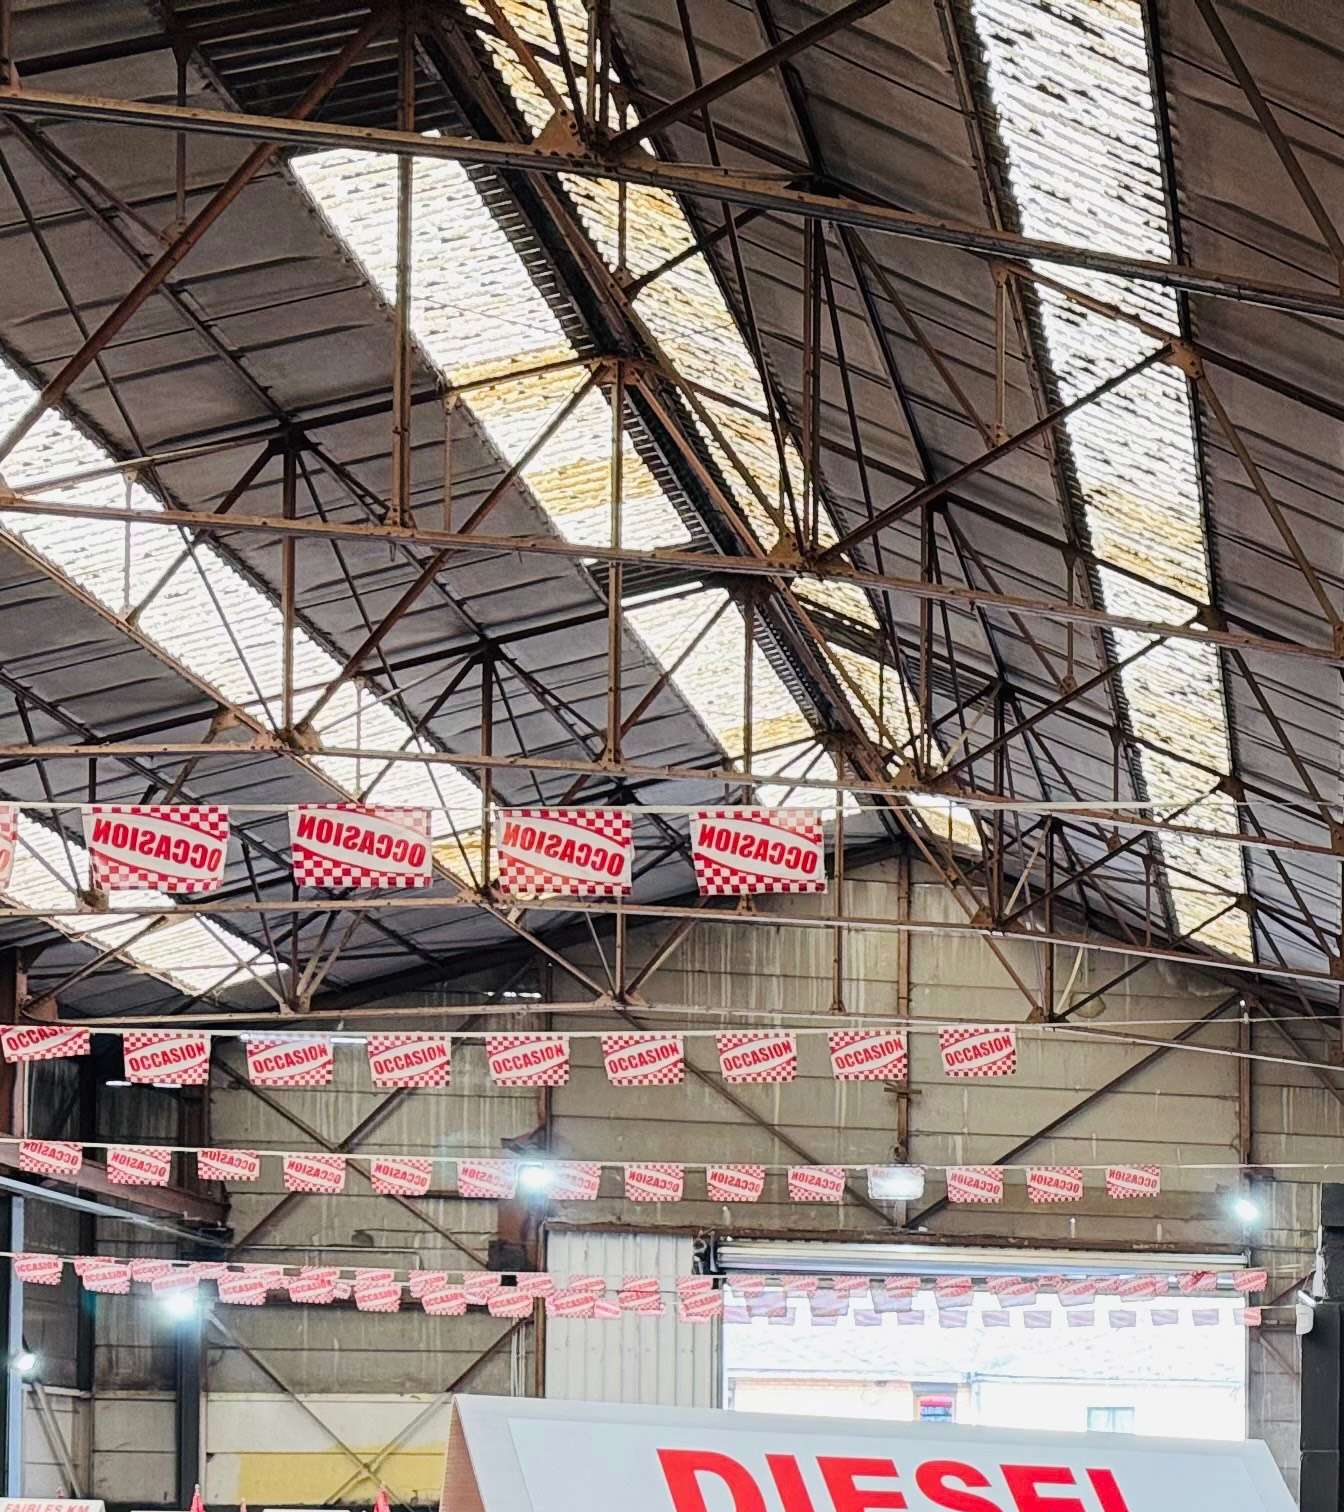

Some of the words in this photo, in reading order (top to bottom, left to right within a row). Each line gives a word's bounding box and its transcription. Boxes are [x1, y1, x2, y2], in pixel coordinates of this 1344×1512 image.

[128, 1042, 205, 1072] OCCASION
[253, 1044, 329, 1073] OCCASION
[374, 1044, 447, 1075] OCCASION
[492, 1042, 565, 1074] OCCASION
[608, 1042, 679, 1074] OCCASION
[723, 1041, 792, 1071] OCCASION
[835, 1037, 903, 1069] OCCASION
[945, 1036, 1012, 1065] OCCASION
